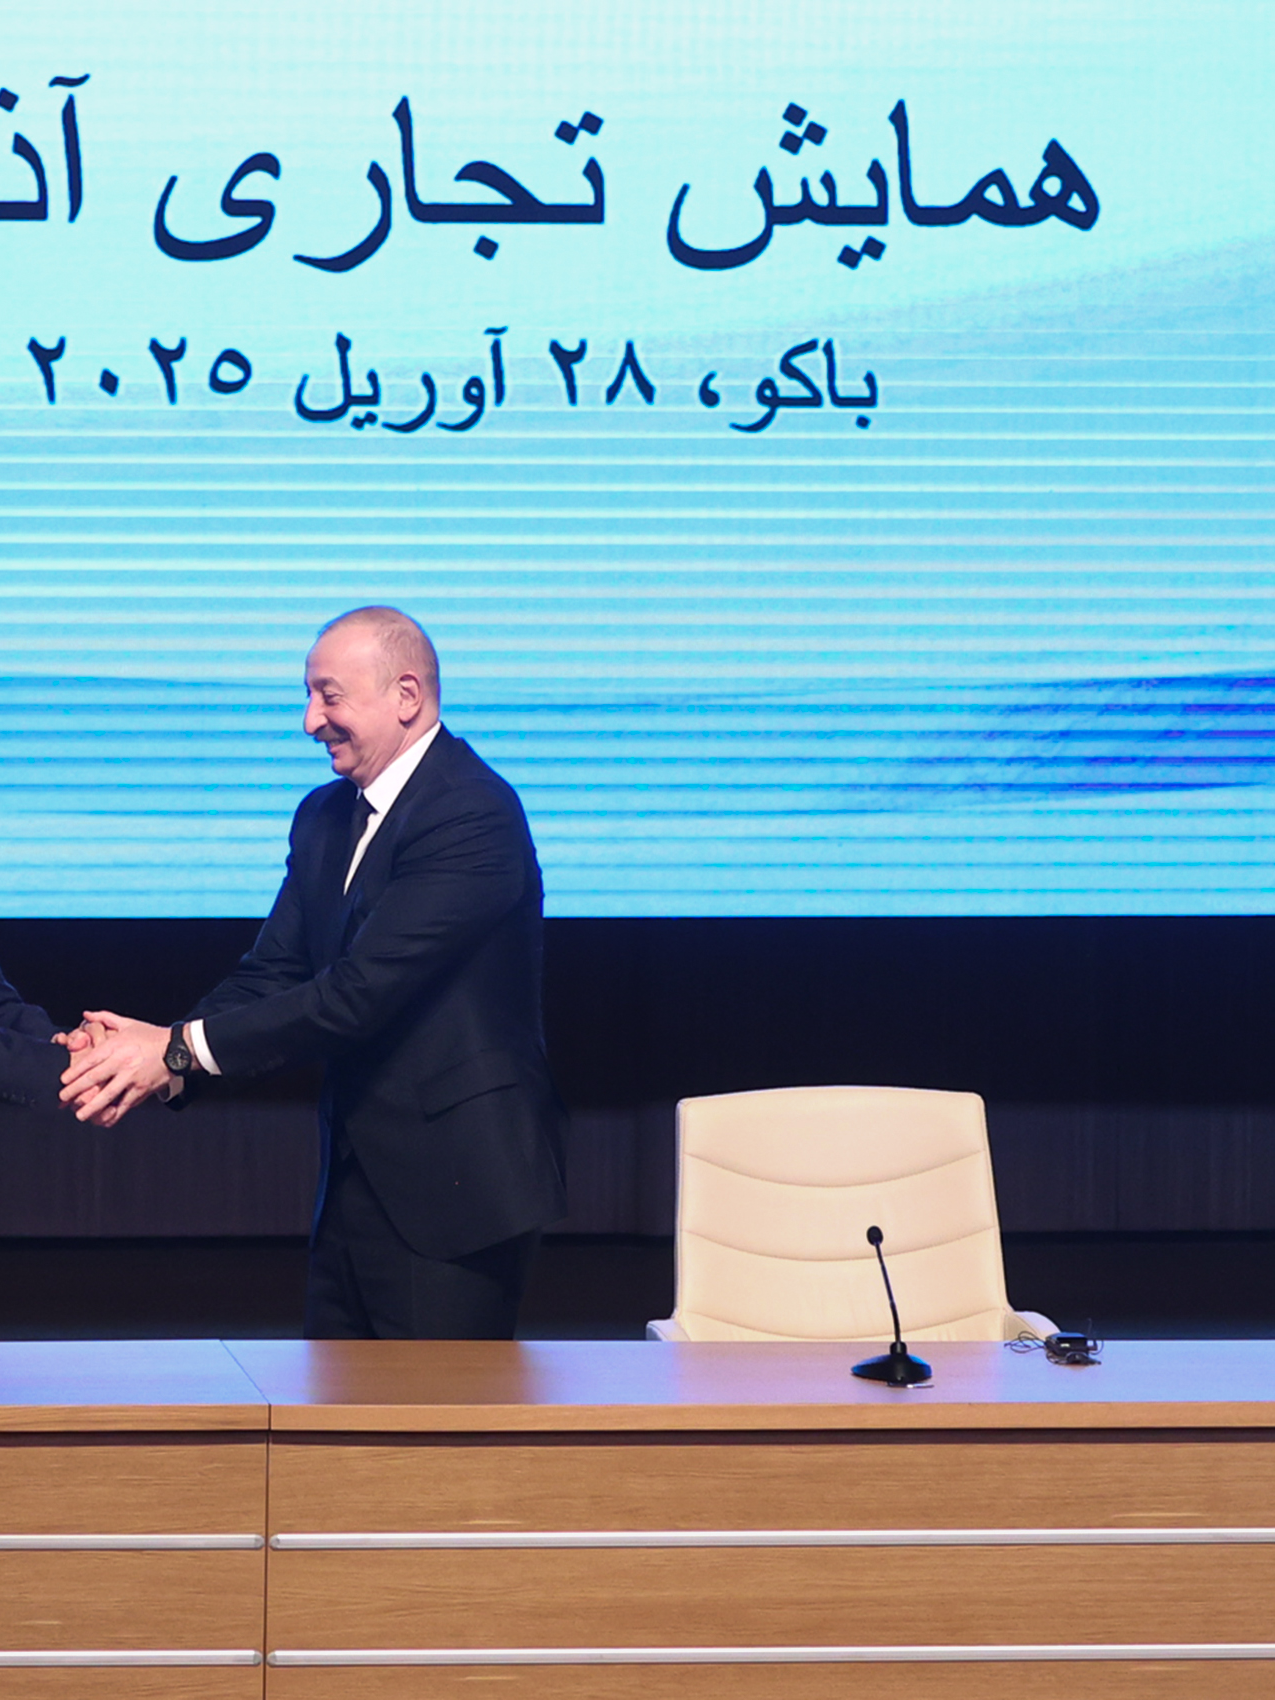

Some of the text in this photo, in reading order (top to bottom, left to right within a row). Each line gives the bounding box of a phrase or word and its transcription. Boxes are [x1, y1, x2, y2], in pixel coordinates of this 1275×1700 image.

[153, 95, 605, 272] تجاری
[666, 99, 1099, 270] همایش
[293, 326, 505, 433] آوریل
[699, 339, 877, 432] باکو،
